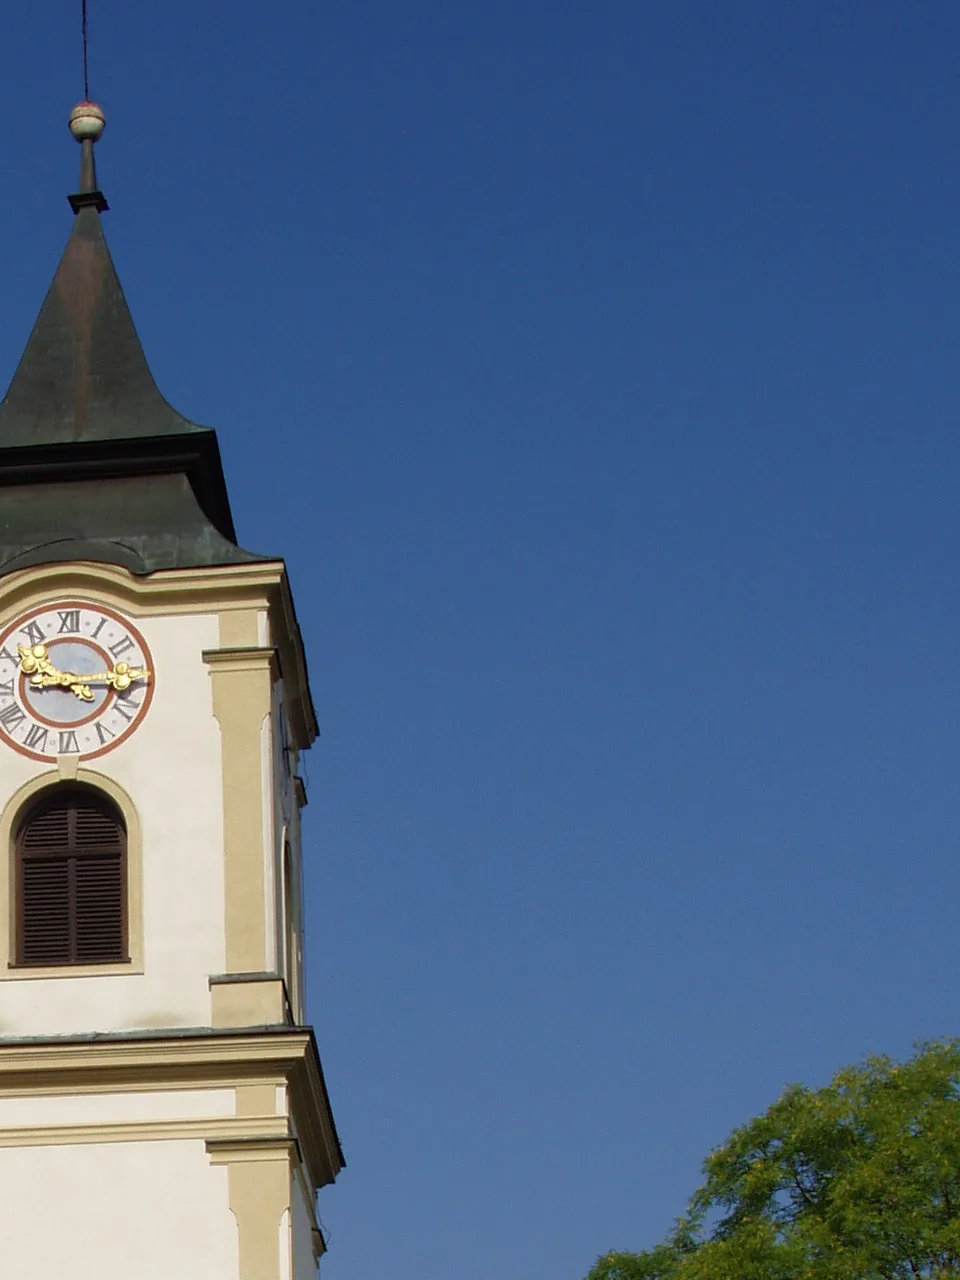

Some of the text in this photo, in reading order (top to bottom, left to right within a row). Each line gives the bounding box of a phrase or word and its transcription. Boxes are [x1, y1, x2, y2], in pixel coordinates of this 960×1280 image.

[19, 620, 47, 645] XI
[57, 610, 81, 633] XII
[91, 617, 108, 638] I
[108, 635, 135, 658] II
[23, 724, 49, 753] VII
[58, 730, 80, 754] VI
[95, 722, 116, 745] V
